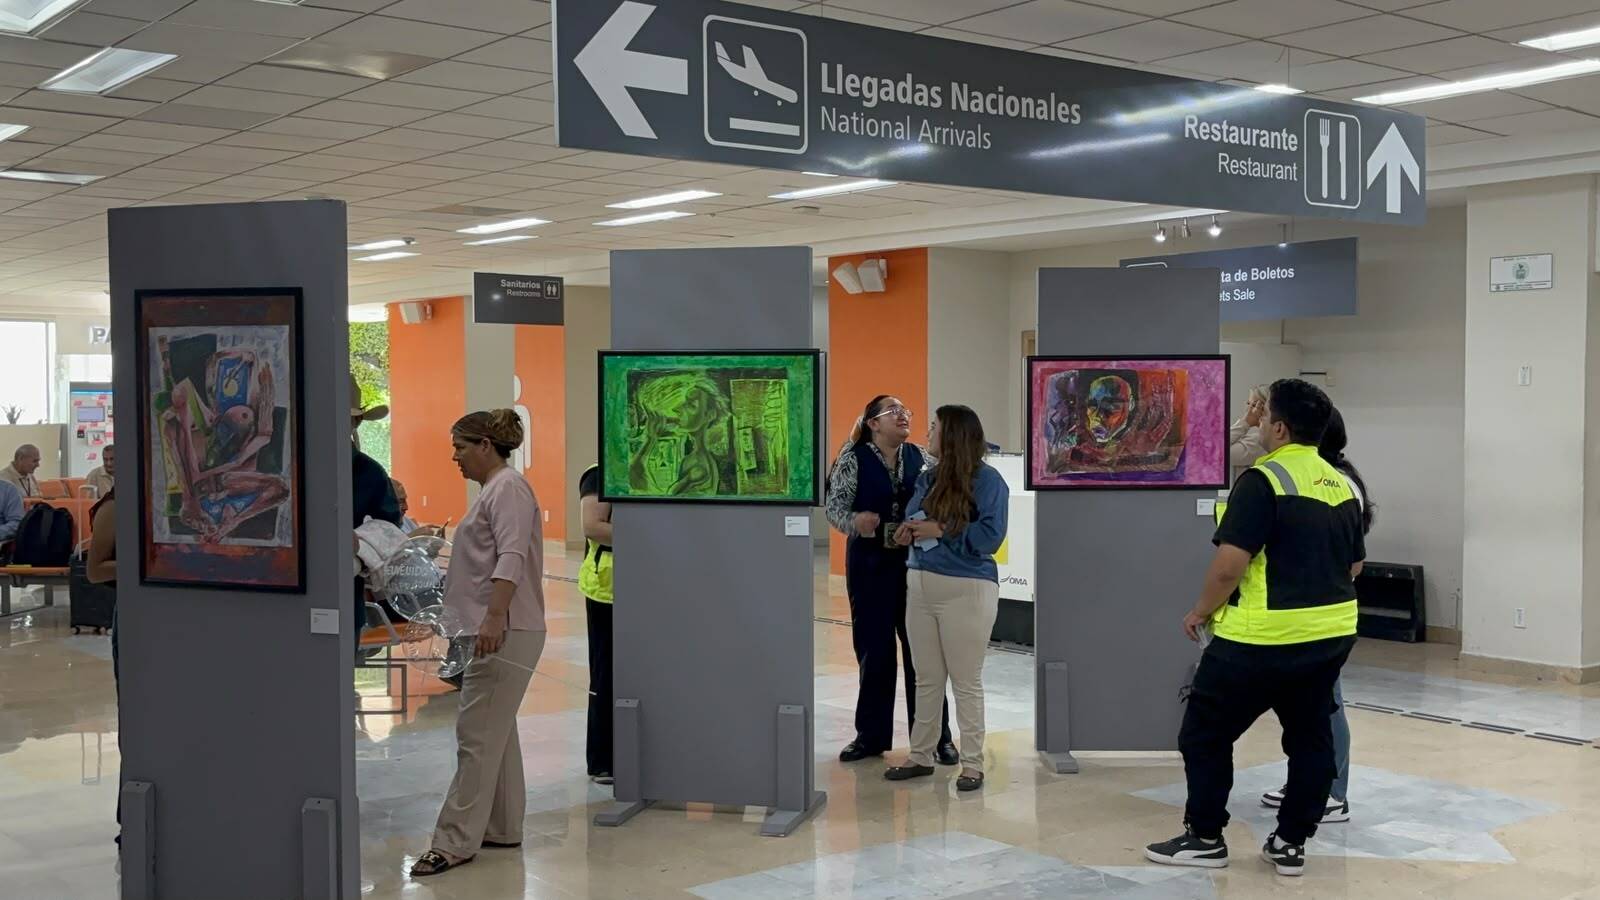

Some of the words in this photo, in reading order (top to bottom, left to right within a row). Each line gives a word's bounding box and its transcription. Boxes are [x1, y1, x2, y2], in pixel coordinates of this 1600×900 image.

[821, 62, 943, 108] Llegadas
[951, 81, 1081, 125] Nacionales
[820, 105, 911, 141] National
[918, 118, 992, 149] Arrivals
[1184, 114, 1298, 152] Restaurante
[1218, 152, 1298, 182] Restaurant
[1234, 269, 1248, 282] de
[1251, 266, 1295, 281] Boletos
[500, 279, 541, 289] Sanitarios
[1233, 288, 1256, 301] Sale
[1322, 478, 1341, 489] OMA
[1009, 576, 1028, 586] OMA
